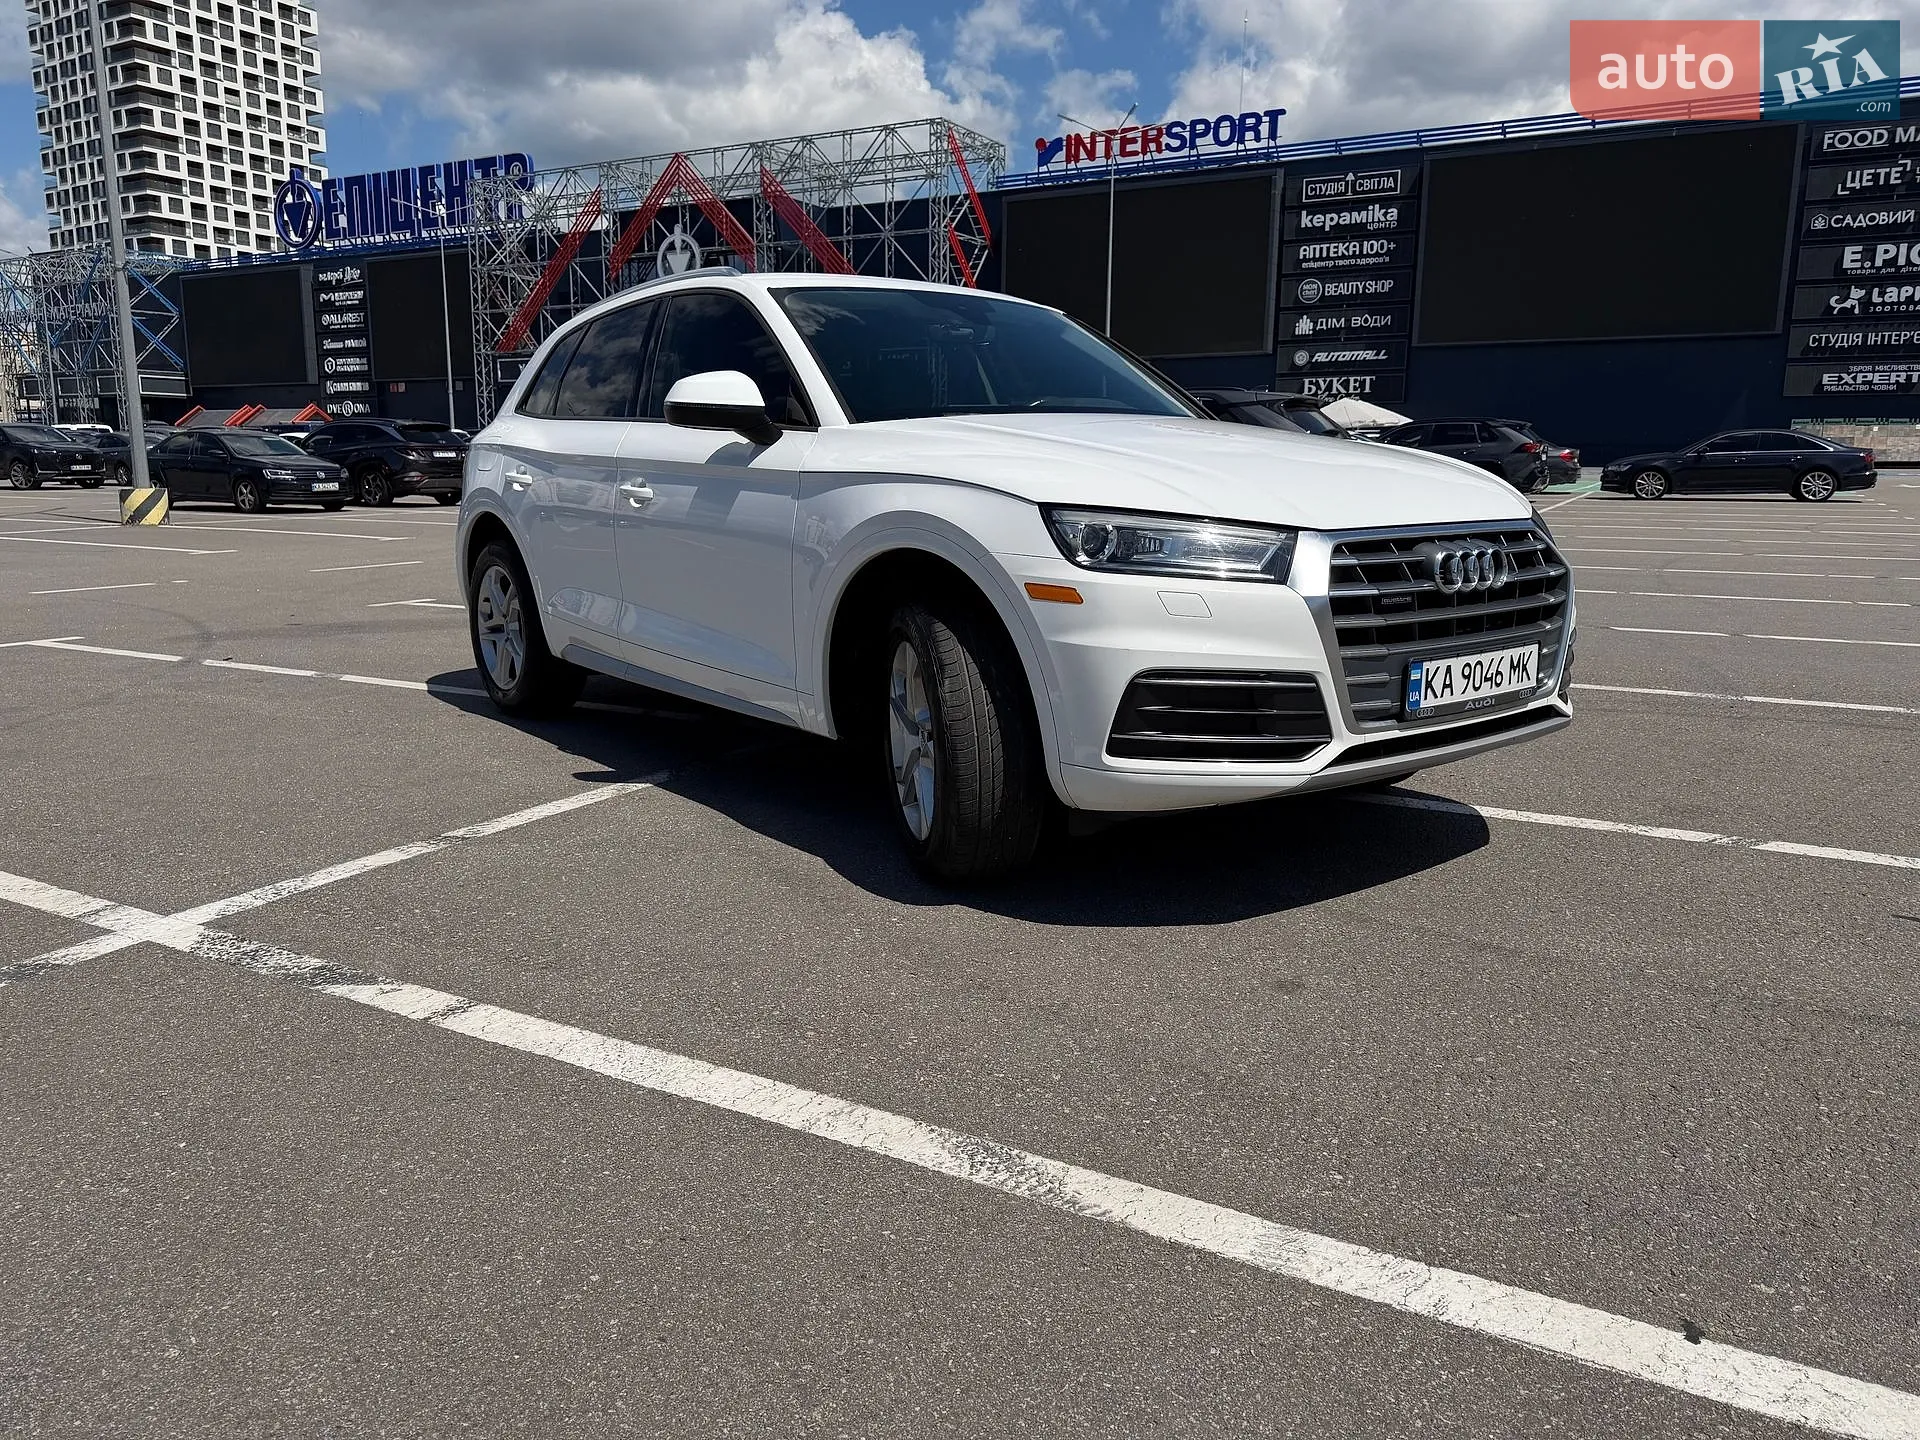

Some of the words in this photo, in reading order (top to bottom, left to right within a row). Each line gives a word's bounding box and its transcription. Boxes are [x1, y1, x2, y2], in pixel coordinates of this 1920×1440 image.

[1065, 108, 1287, 165] INTERSPORT
[1823, 129, 1889, 150] FOOD
[1895, 125, 1920, 144] M
[1307, 181, 1346, 197] СТУДІЯ
[1355, 176, 1395, 192] СВІТЛА
[1845, 166, 1904, 190] ЦЕТЕ
[1367, 220, 1398, 231] центр
[1830, 209, 1916, 229] САДОВИЙ
[1299, 241, 1360, 260] АПТЕКА
[1324, 281, 1366, 297] BEAUTY
[1365, 278, 1394, 293] SHOP
[1316, 317, 1345, 331] ДІМ
[1351, 313, 1392, 328] ВОДИ
[1809, 332, 1863, 348] СТУДІЯ
[1311, 349, 1389, 363] AUTOMALL
[1875, 364, 1920, 372] МИСЛИВСТВ
[1302, 375, 1376, 396] БУКЕТ
[1821, 371, 1920, 385] EXPERT
[1823, 384, 1870, 392] РИБАЛЬСТВО
[1871, 383, 1897, 391] ЧОВНИ
[1423, 664, 1454, 701] KA
[1460, 655, 1505, 695] 9046
[1507, 650, 1534, 686] MK
[1409, 690, 1420, 702] UA
[1464, 697, 1496, 710] Audi
